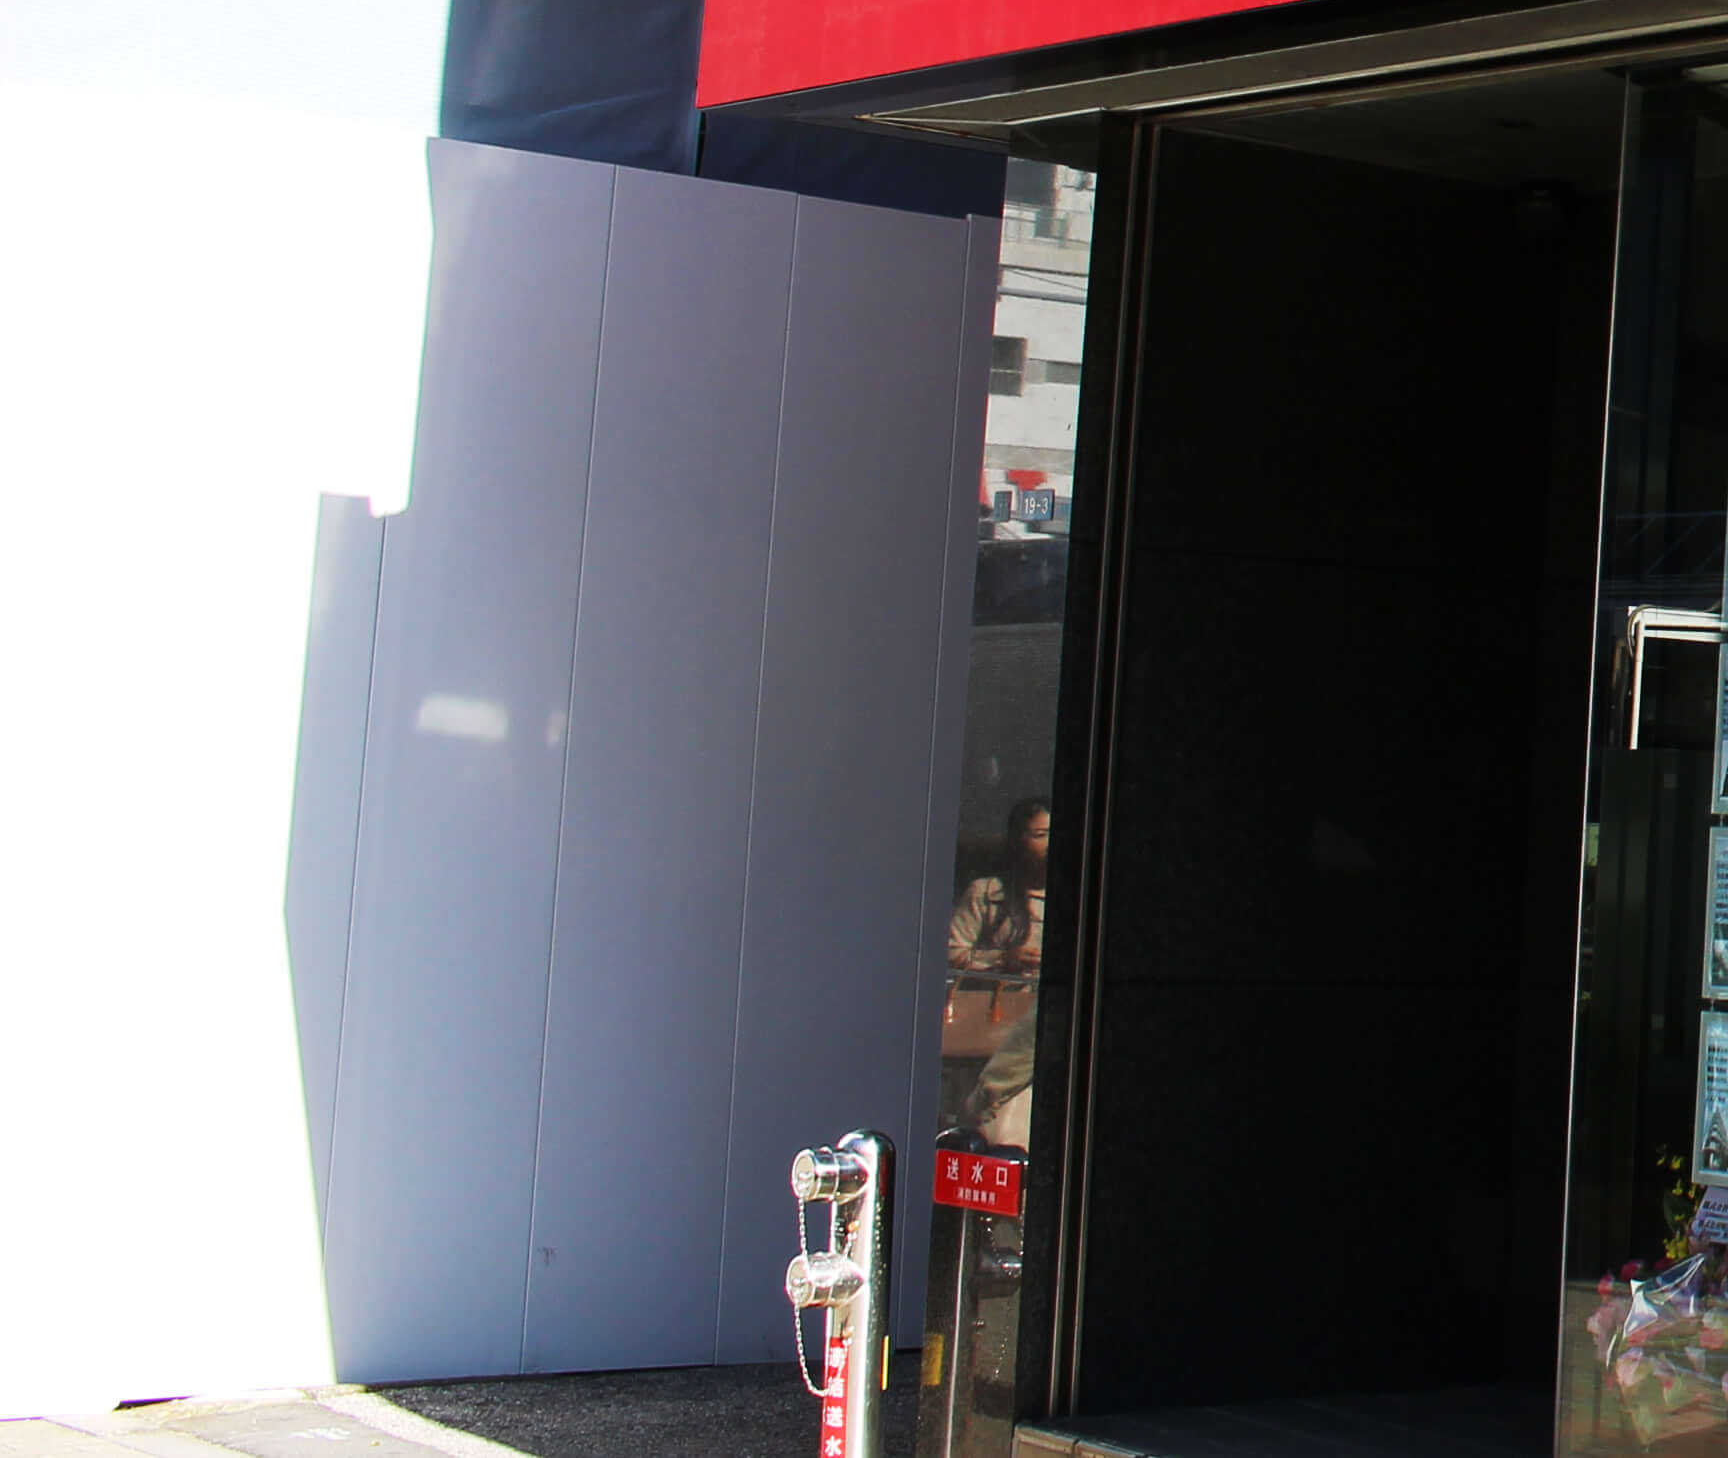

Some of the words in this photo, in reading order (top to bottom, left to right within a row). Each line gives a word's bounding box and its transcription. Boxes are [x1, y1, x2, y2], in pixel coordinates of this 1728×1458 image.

[1025, 497, 1049, 515] 19-3
[946, 1157, 1009, 1188] 送水口
